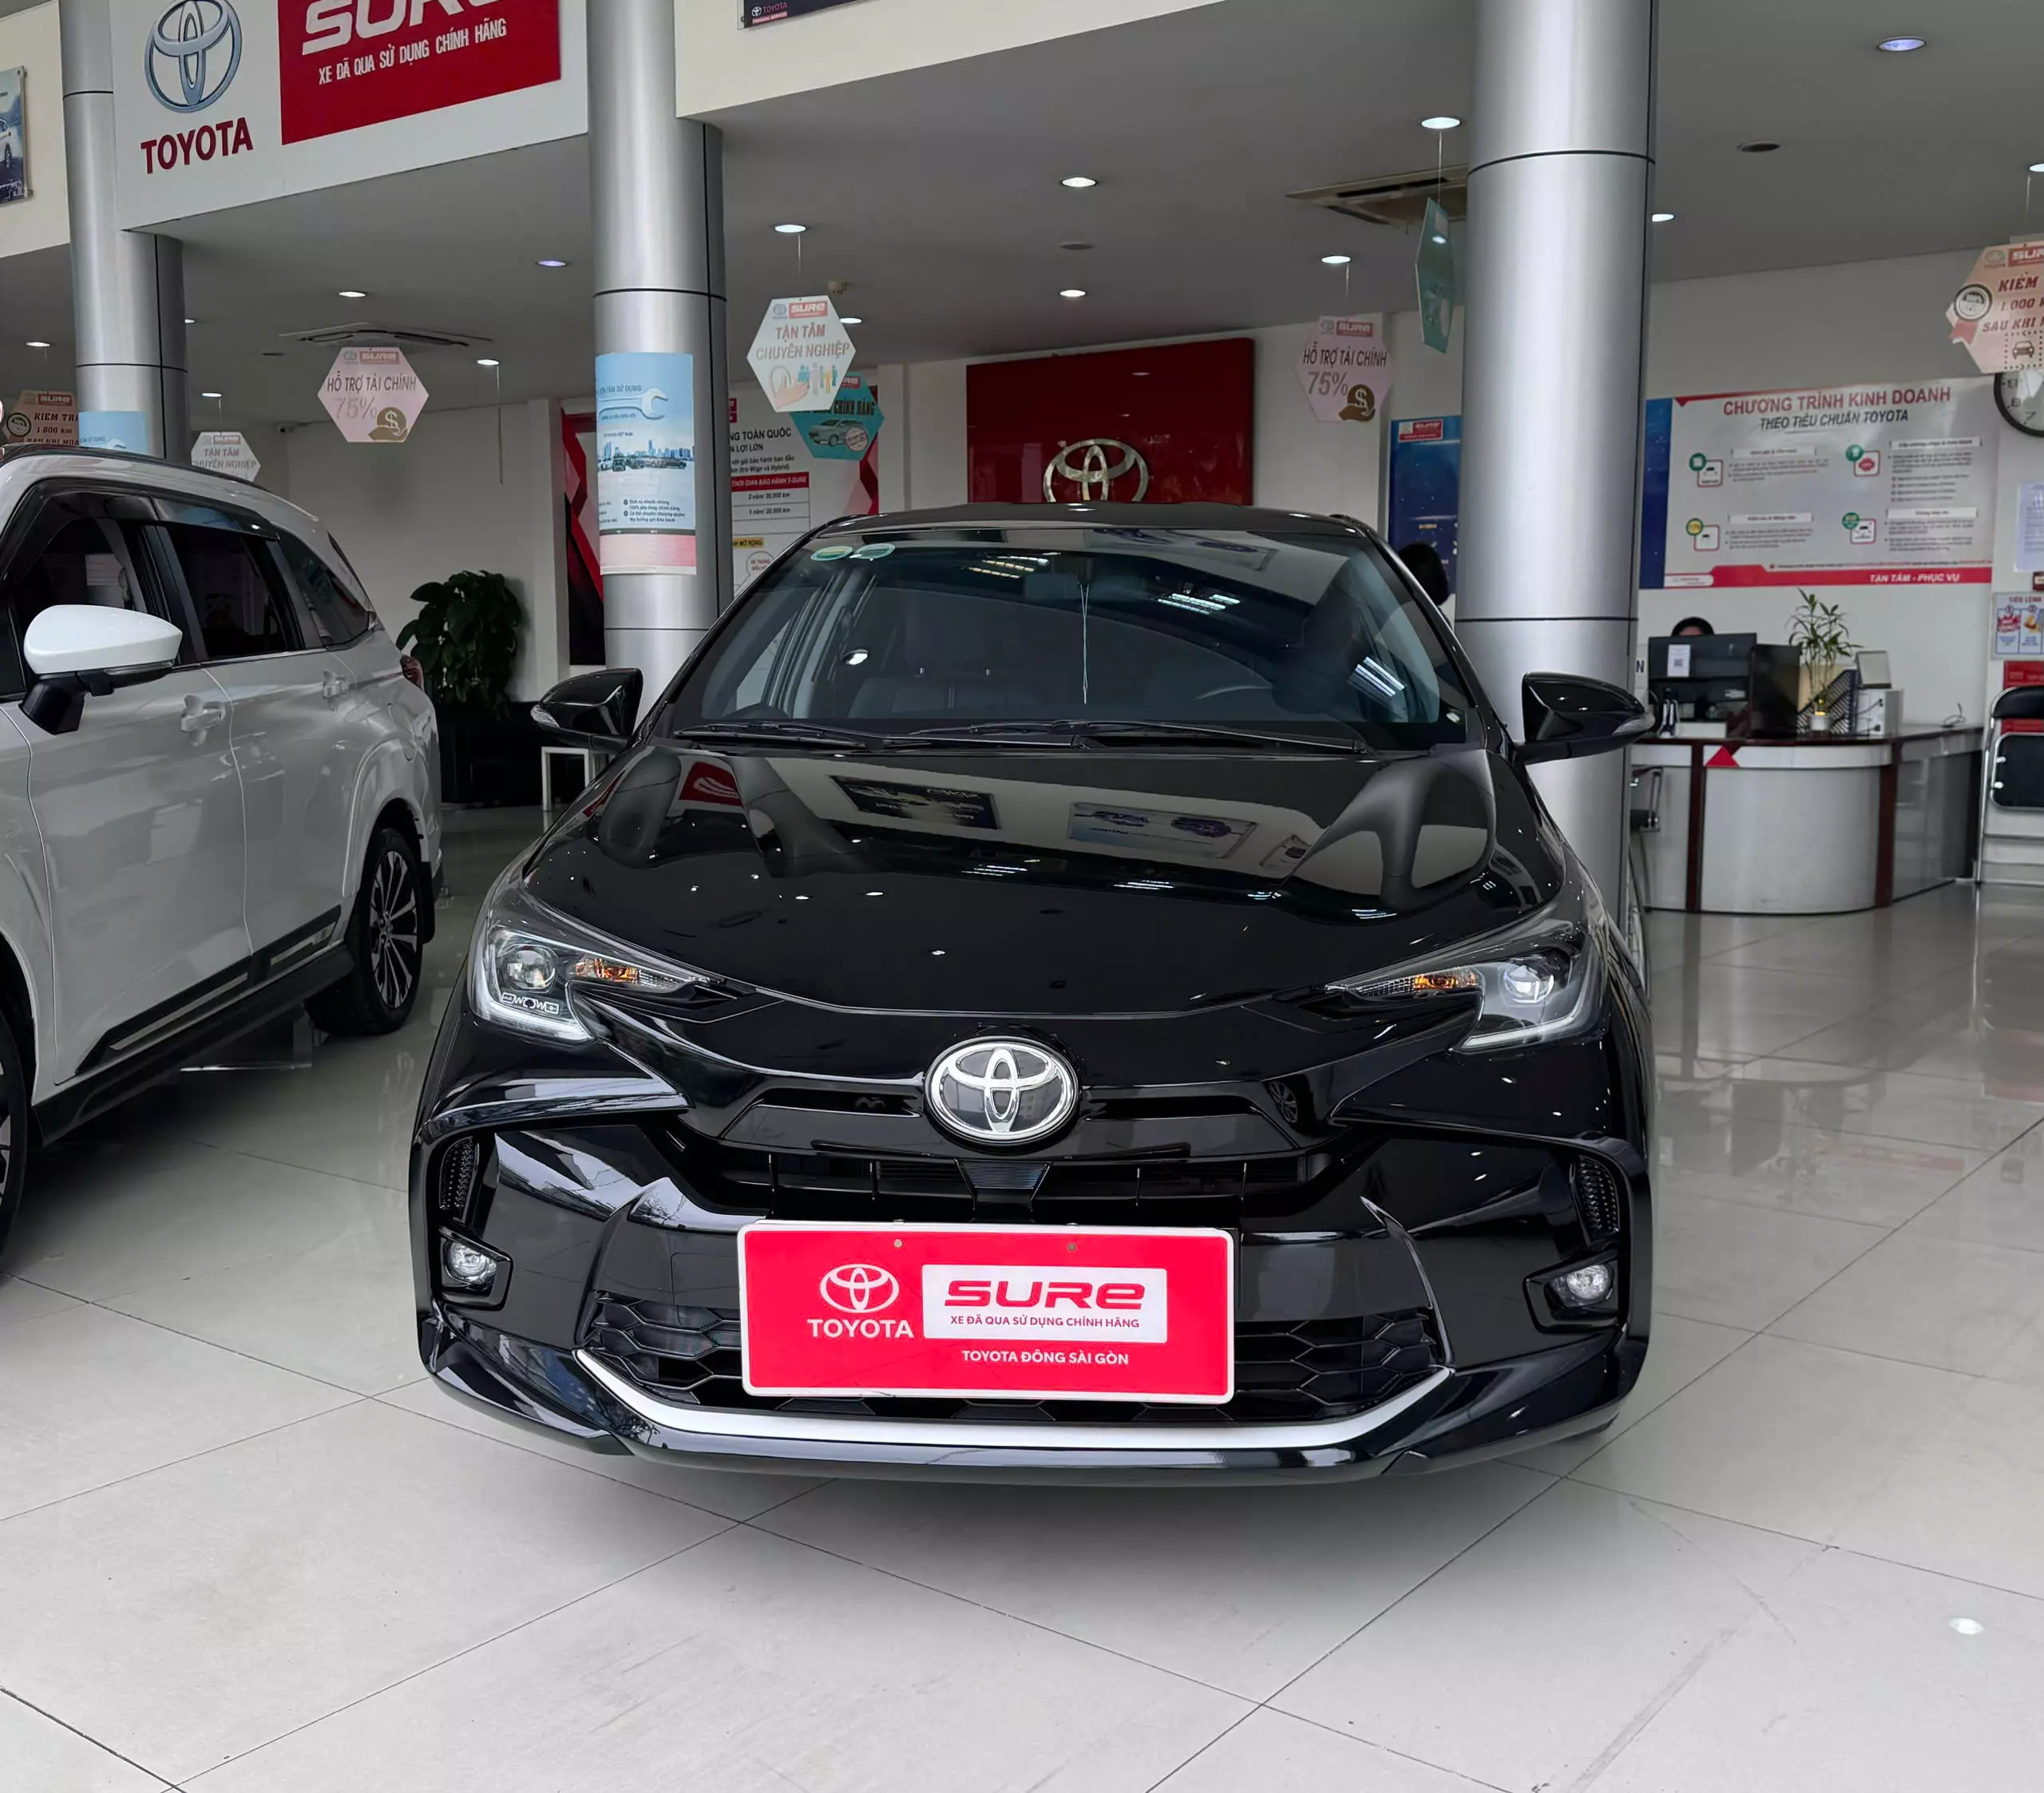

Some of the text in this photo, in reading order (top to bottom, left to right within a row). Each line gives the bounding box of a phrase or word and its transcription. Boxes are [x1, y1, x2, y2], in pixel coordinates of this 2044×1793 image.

[302, 0, 500, 55] SU
[319, 65, 332, 85] XE
[336, 57, 351, 81] ĐÃ
[354, 54, 375, 75] QUA
[379, 44, 395, 69] SỬ
[399, 39, 430, 65] DỤNG
[435, 27, 469, 53] CHÍNH
[141, 117, 253, 174] TOYOTA
[775, 322, 826, 342] TẬN TÂM
[1983, 318, 2034, 332] SAU KHI
[755, 340, 850, 361] CHUYÊN NGHIỆP
[1357, 346, 1387, 367] CHÍNH
[1308, 371, 1348, 396] 75%
[334, 397, 378, 419] 75%
[1723, 386, 1951, 415] CHƯƠNG TRÌNH KINH DOANH
[1761, 416, 1789, 429] THEO
[1864, 409, 1908, 423] TOYOTA
[743, 428, 765, 440] TOÀN
[766, 425, 791, 438] QUỐC
[807, 1319, 914, 1339] TOYOTA
[950, 1314, 1139, 1328] XE ĐÃ QUA SỬ DỤNG CHÍNH HÃNG
[962, 1348, 1129, 1365] TOYOTA ĐÔNG SÀI GÒN
